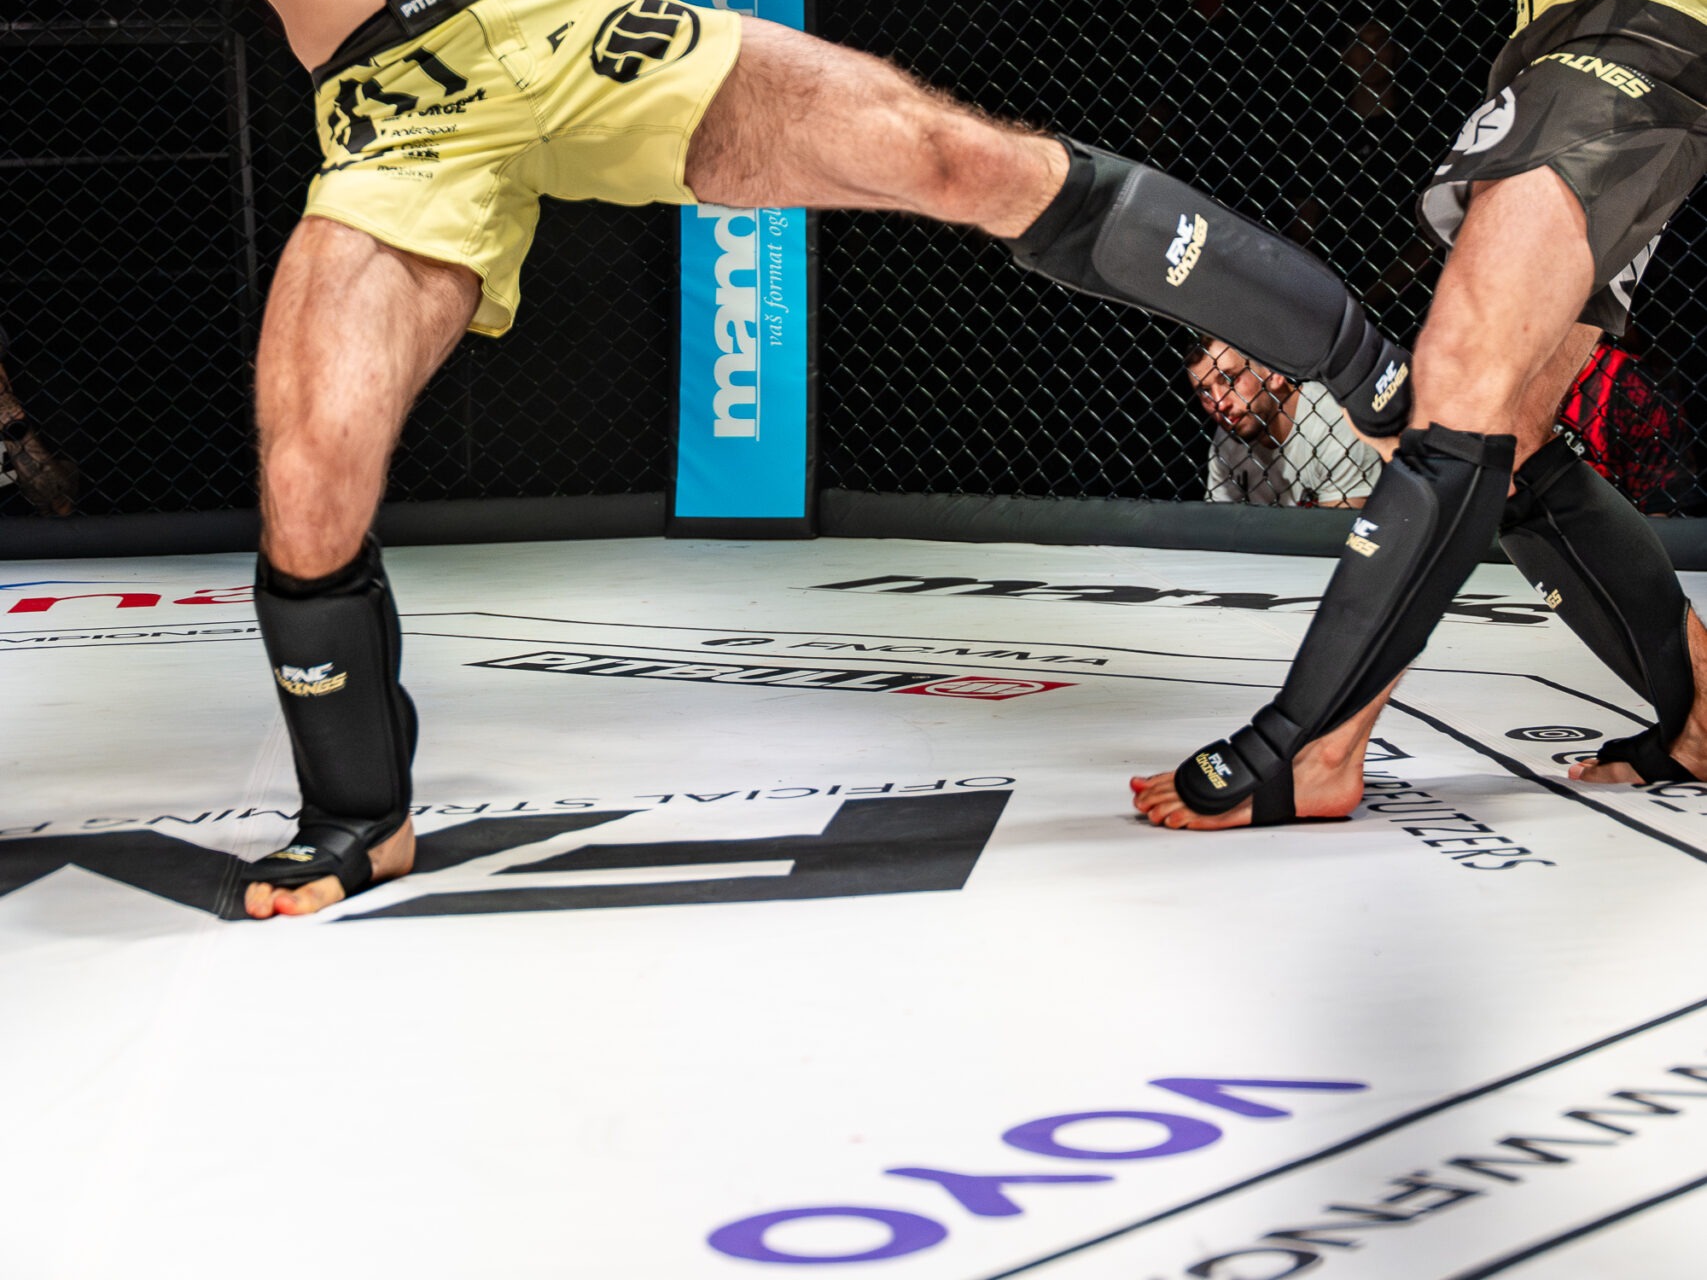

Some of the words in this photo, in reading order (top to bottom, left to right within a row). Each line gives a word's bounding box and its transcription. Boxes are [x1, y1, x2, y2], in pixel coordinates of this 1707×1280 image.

[1166, 214, 1194, 265] FNC
[1166, 213, 1208, 286] VIKINGS
[763, 244, 789, 312] format
[697, 205, 757, 437] mand
[764, 314, 783, 347] vaš
[1375, 360, 1397, 394] FNC
[786, 641, 1108, 666] FNC.MMA
[282, 662, 334, 683] FNC
[488, 652, 903, 691] PITBULL
[1195, 753, 1228, 790] VIKINGS
[1207, 752, 1233, 776] FNC
[634, 776, 1016, 804] OFFICIAL
[83, 797, 600, 829] STREMING
[705, 1075, 1371, 1265] VOYO
